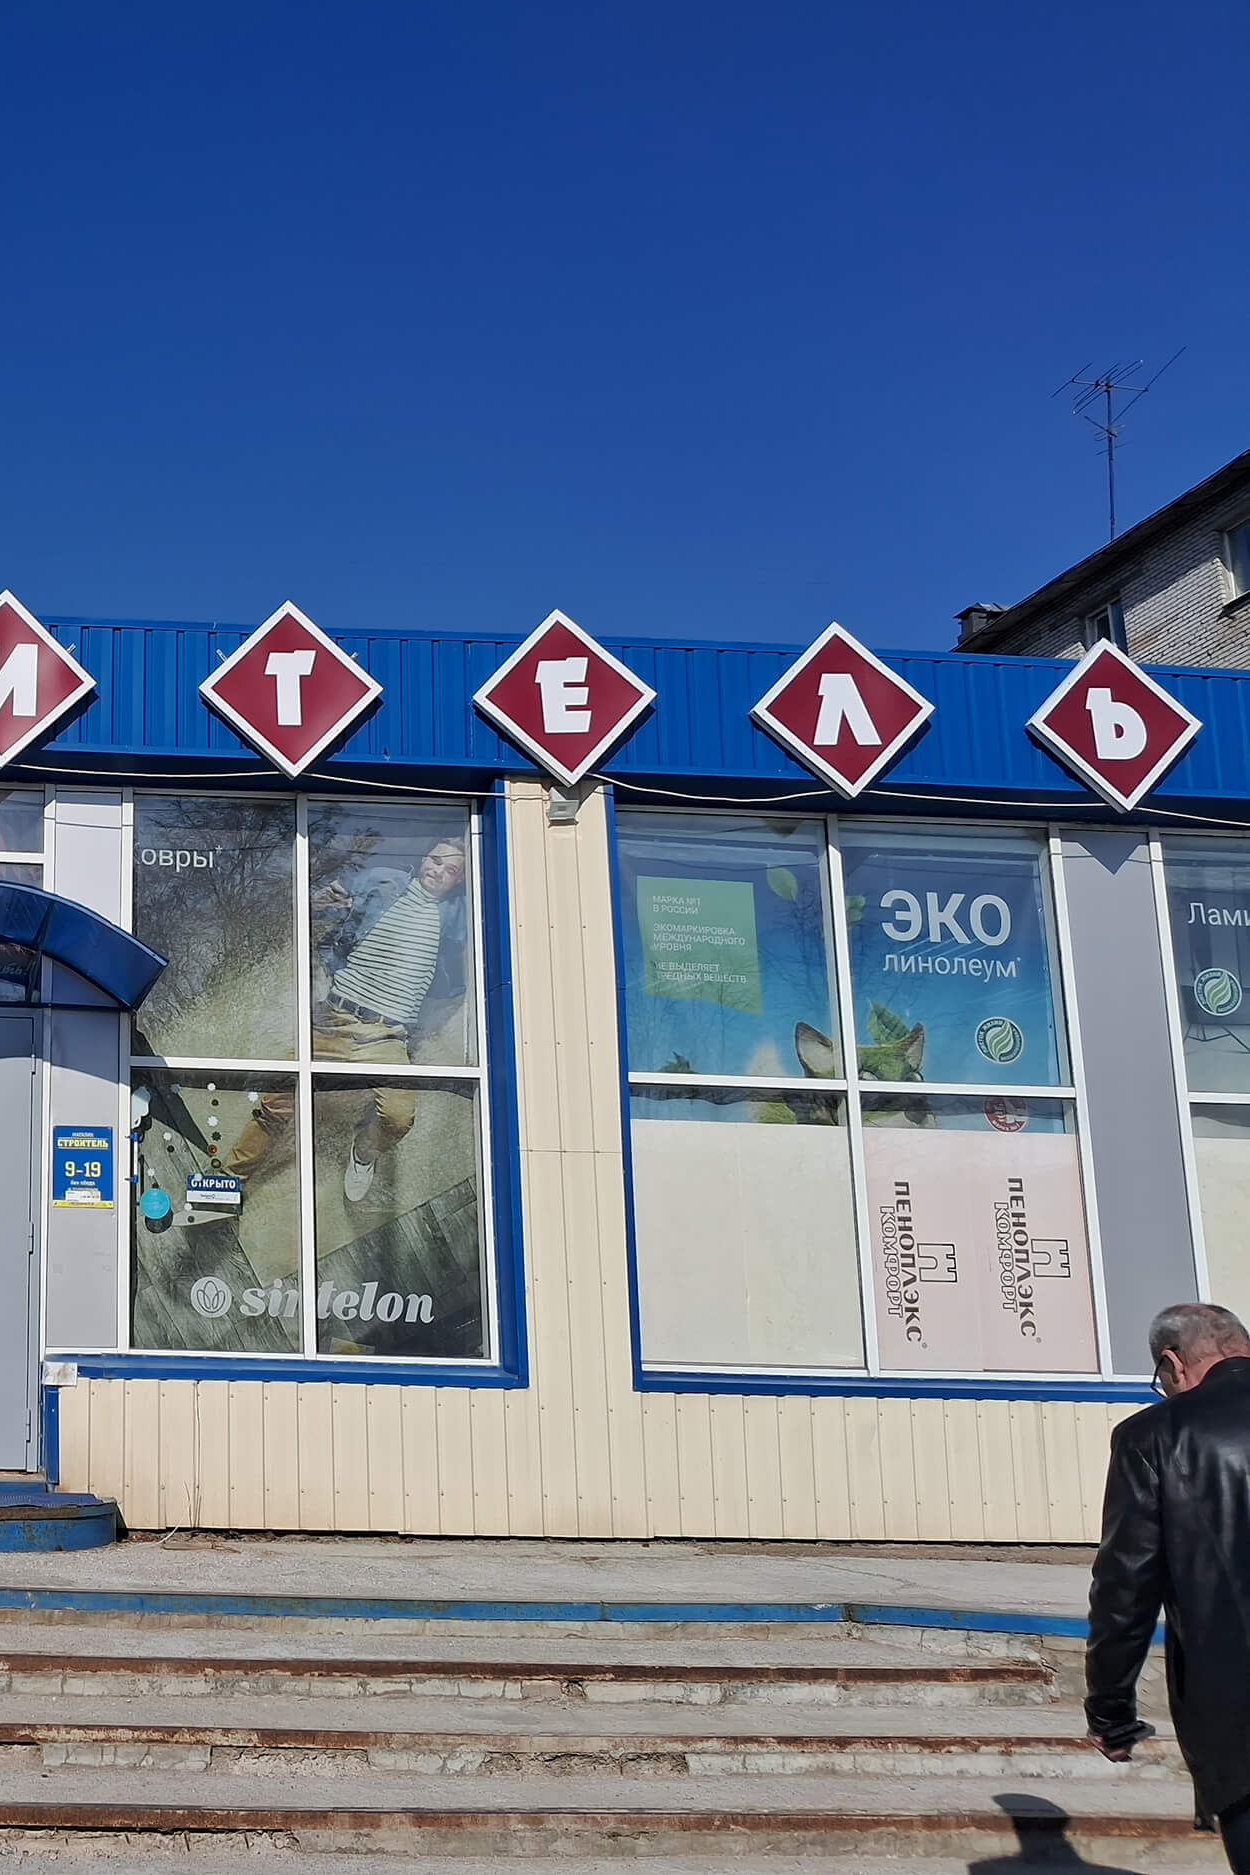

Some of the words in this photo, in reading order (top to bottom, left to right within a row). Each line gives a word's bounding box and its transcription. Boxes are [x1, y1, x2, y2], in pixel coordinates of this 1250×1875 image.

[652, 895, 684, 905] МАРКА
[653, 904, 659, 912] В
[661, 905, 699, 914] РОССИИ
[880, 889, 1012, 946] ЭКО
[653, 923, 735, 935] ЭКОМАРКИРОВКА
[653, 933, 746, 946] МЕЖДУНАРОДНОГО
[653, 942, 693, 952] УРОВНЯ
[669, 962, 719, 972] ВЫДЕЛЯЕТ
[703, 973, 747, 983] ВЕЩЕСТВ
[65, 1161, 101, 1177] 9-19
[880, 1206, 903, 1318] КОМФОРТ
[894, 1181, 922, 1342] ПЕНОПЛЭКС
[994, 1202, 1017, 1312] КОМФОРТ
[1008, 1177, 1036, 1337] ПЕНОПЛЭКС
